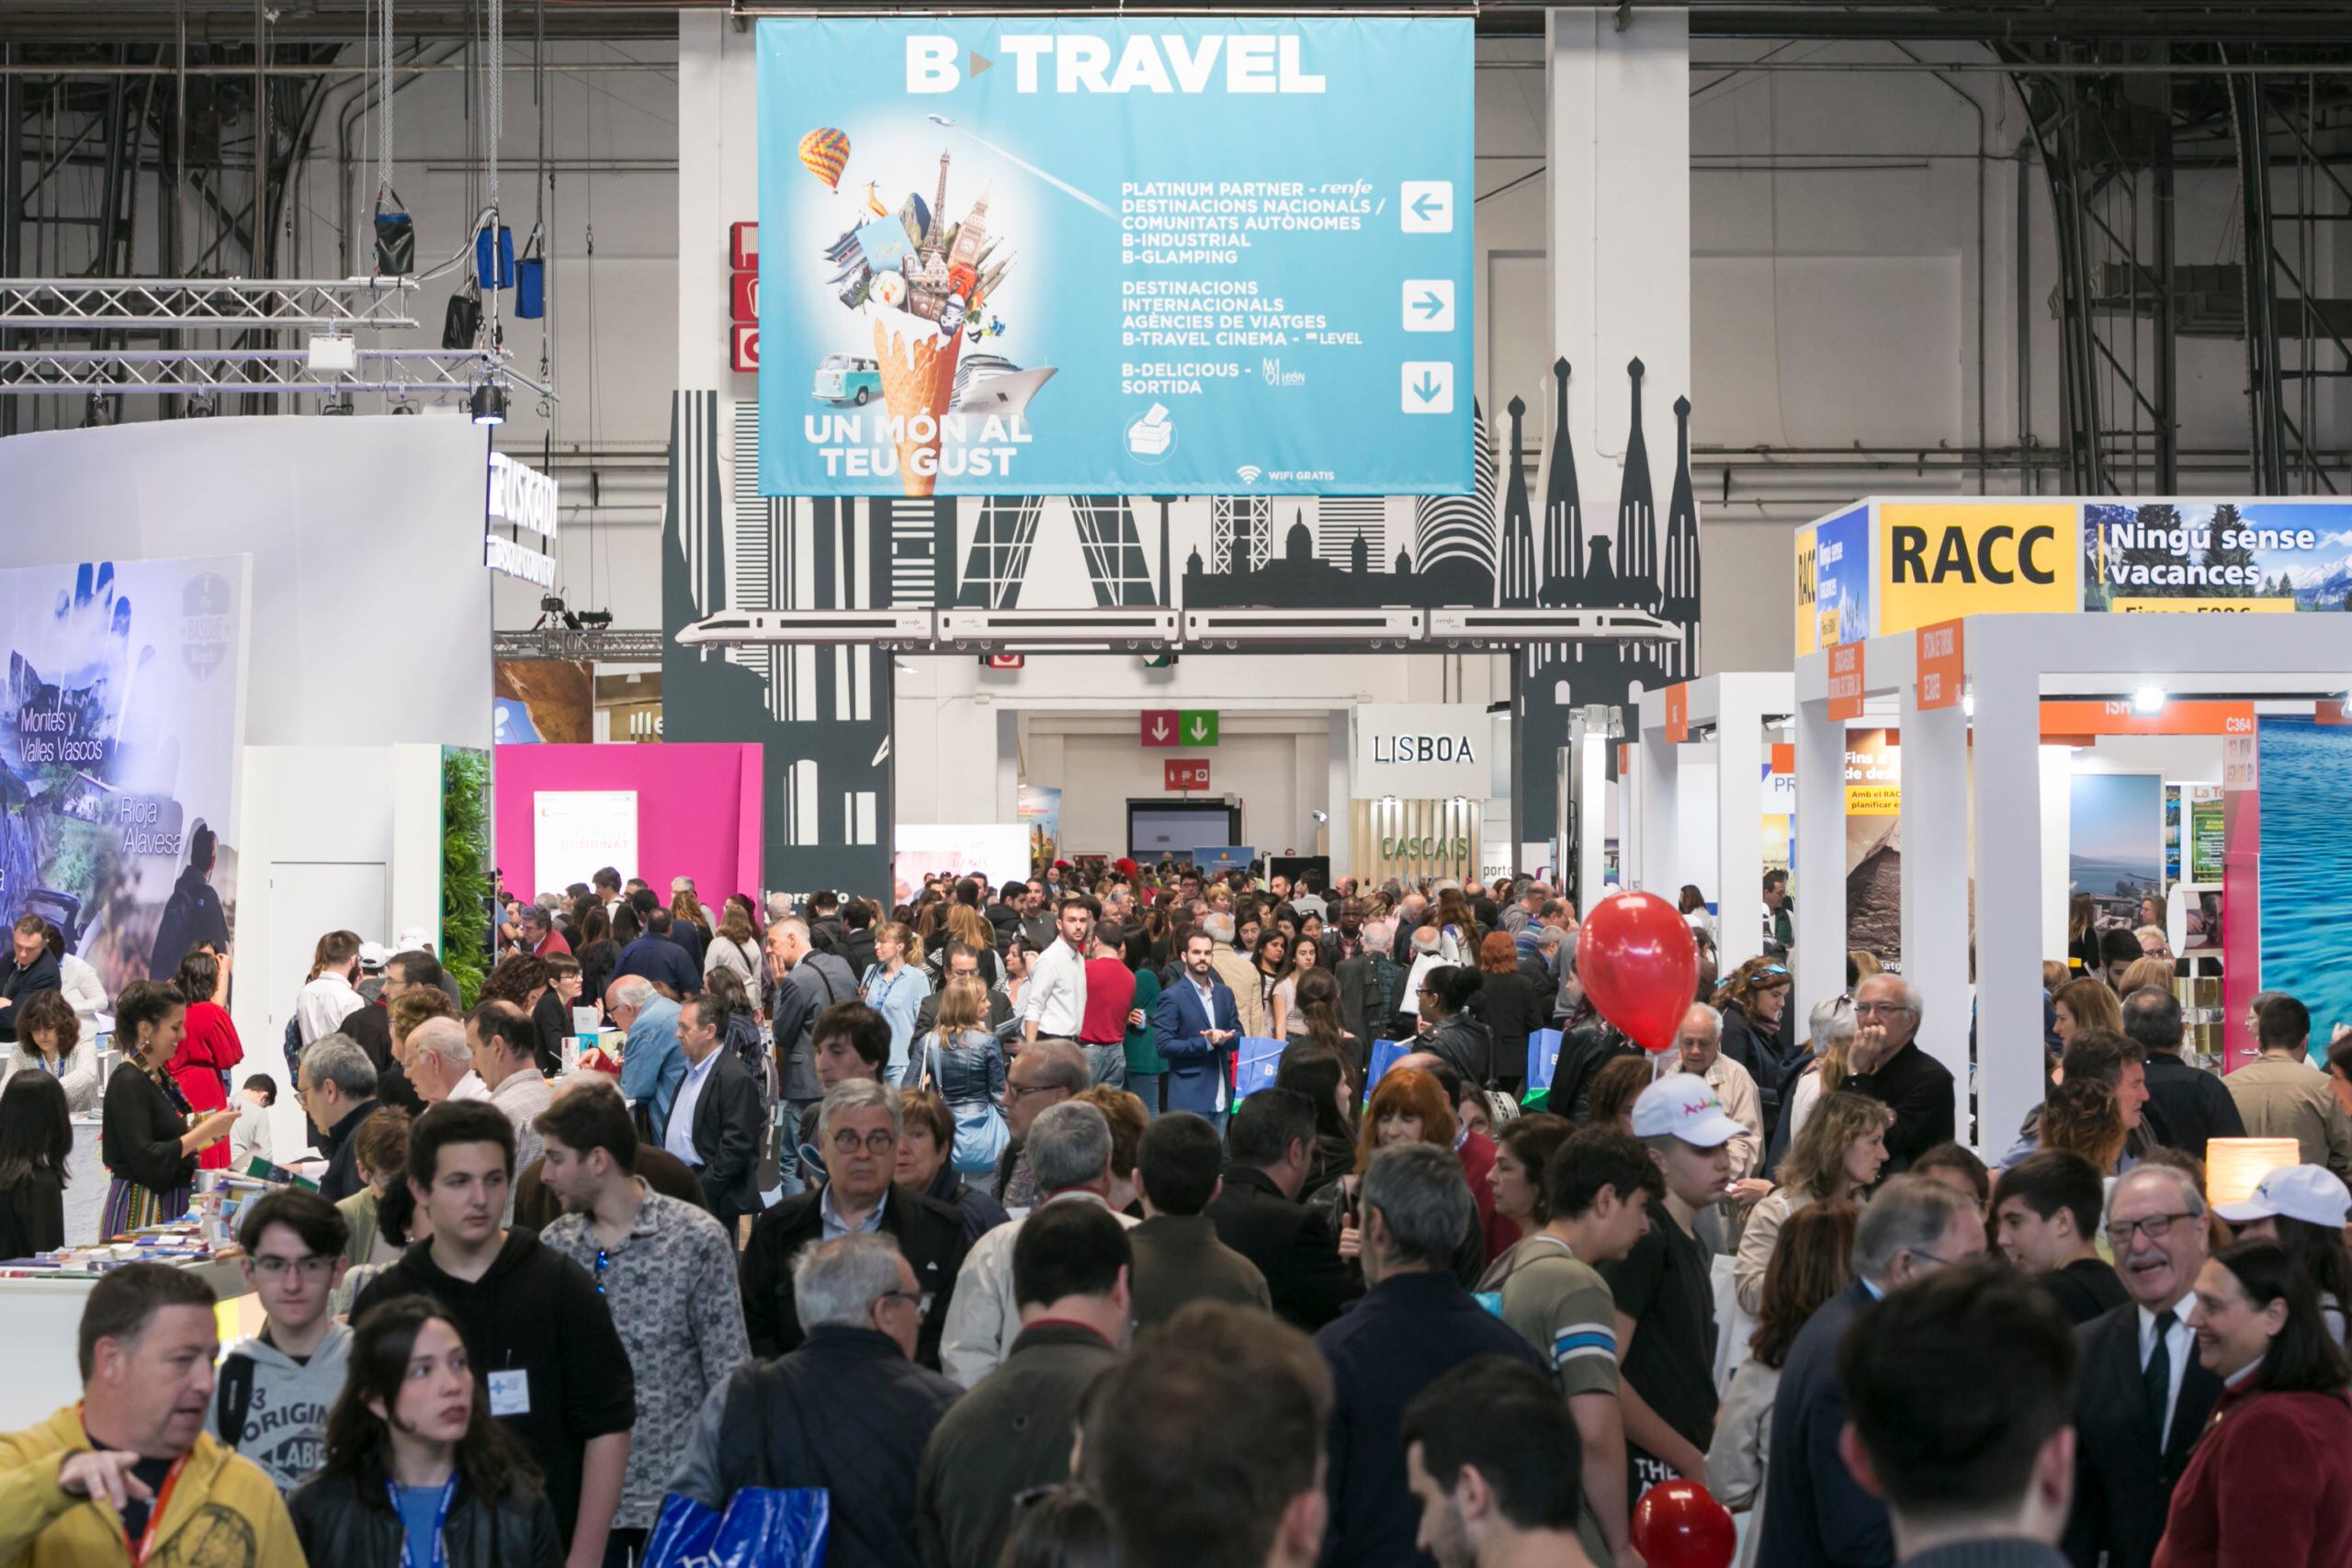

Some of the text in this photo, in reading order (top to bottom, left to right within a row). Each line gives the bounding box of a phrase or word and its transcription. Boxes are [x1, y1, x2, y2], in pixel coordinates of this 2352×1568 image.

[906, 35, 1327, 94] B TRAVEL
[1122, 182, 1214, 197] PLATINUM
[1219, 182, 1304, 197] PARTNER
[1320, 178, 1374, 198] renfe
[1122, 198, 1258, 213] DESTINACIONS
[1263, 198, 1372, 213] NACIONALS
[1122, 211, 1362, 231] COMUNITATS AUTÒNOMES
[1122, 232, 1251, 247] B-INDUSTRIAL
[1122, 250, 1238, 265] B-GLAMPING
[1122, 280, 1259, 295] DESTINACIONS
[1122, 298, 1284, 312] INTERNACIONALS
[1122, 311, 1327, 330] AGÈNCIES DE VIATGES
[1122, 332, 1211, 346] B-TRAVEL
[1216, 332, 1287, 346] CINEMA
[1319, 332, 1363, 344] LEVEL
[1122, 363, 1238, 378] B-DELICIOUS
[1122, 379, 1203, 394] SORTIDA
[804, 406, 1033, 444] UN MÓN AL
[819, 446, 1017, 477] TEU GUST
[1268, 471, 1335, 480] WIFI GRATIS
[488, 452, 559, 540] EUSKADI
[2111, 522, 2315, 556] Ningú sense
[1891, 525, 2055, 585] RACC
[2110, 562, 2260, 586] vacances
[20, 707, 77, 736] Montes y
[2225, 716, 2251, 732] C364
[20, 737, 103, 762] Valles Vascos
[1374, 735, 1475, 762] LISBOA
[2194, 786, 2210, 798] La
[120, 796, 158, 829] Rioja
[1851, 801, 1892, 809] planificar
[122, 828, 183, 854] Alavesa
[1382, 837, 1468, 861] CASCAIS
